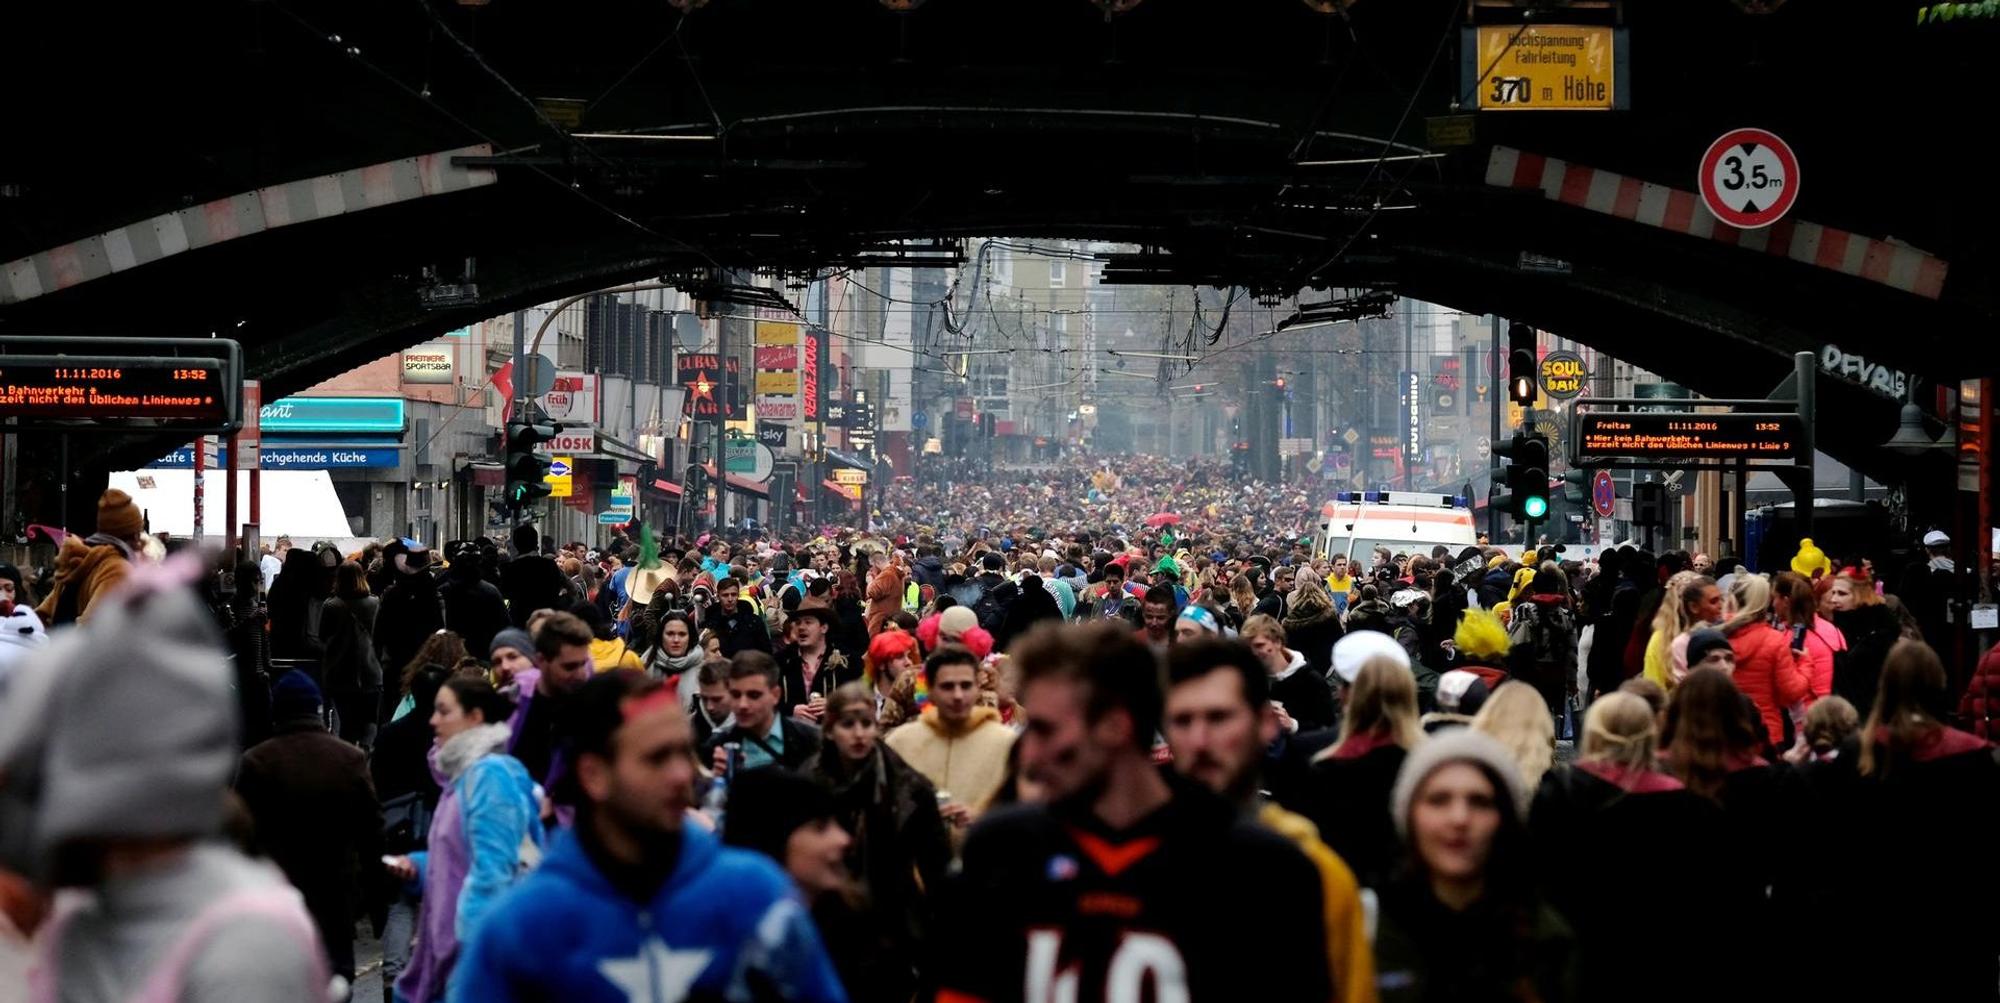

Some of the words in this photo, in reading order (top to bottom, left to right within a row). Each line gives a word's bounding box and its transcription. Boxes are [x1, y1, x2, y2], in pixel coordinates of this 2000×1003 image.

[1508, 33, 1585, 50] Hochspannung
[1515, 49, 1577, 67] Fahrleitung
[1542, 86, 1553, 101] m
[1564, 74, 1606, 102] Höhe
[55, 369, 121, 379] 11.11.2016
[173, 369, 207, 380] 13:52
[1541, 361, 1584, 376] SOUL
[804, 335, 817, 418] RENDEZVOUS
[8, 385, 85, 395] Bahnverkehr
[29, 393, 59, 404] nicht
[63, 394, 86, 404] den
[143, 394, 201, 405] Linienweg
[1596, 422, 1631, 430] Freitag
[1668, 422, 1718, 431] 11.11.2016
[1755, 423, 1780, 431] 13:52
[763, 429, 784, 442] sky
[1593, 434, 1612, 442] Hier
[1614, 434, 1632, 442] kein
[1634, 434, 1691, 442] Bahnverkehr
[546, 437, 591, 450] KIOSK
[1586, 441, 1619, 449] zurzeit
[1621, 440, 1644, 449] nicht
[1647, 441, 1664, 449] den
[1759, 441, 1780, 450] Linie
[1783, 442, 1790, 450] 9
[260, 451, 327, 467] rchgehende
[332, 450, 367, 463] Küche
